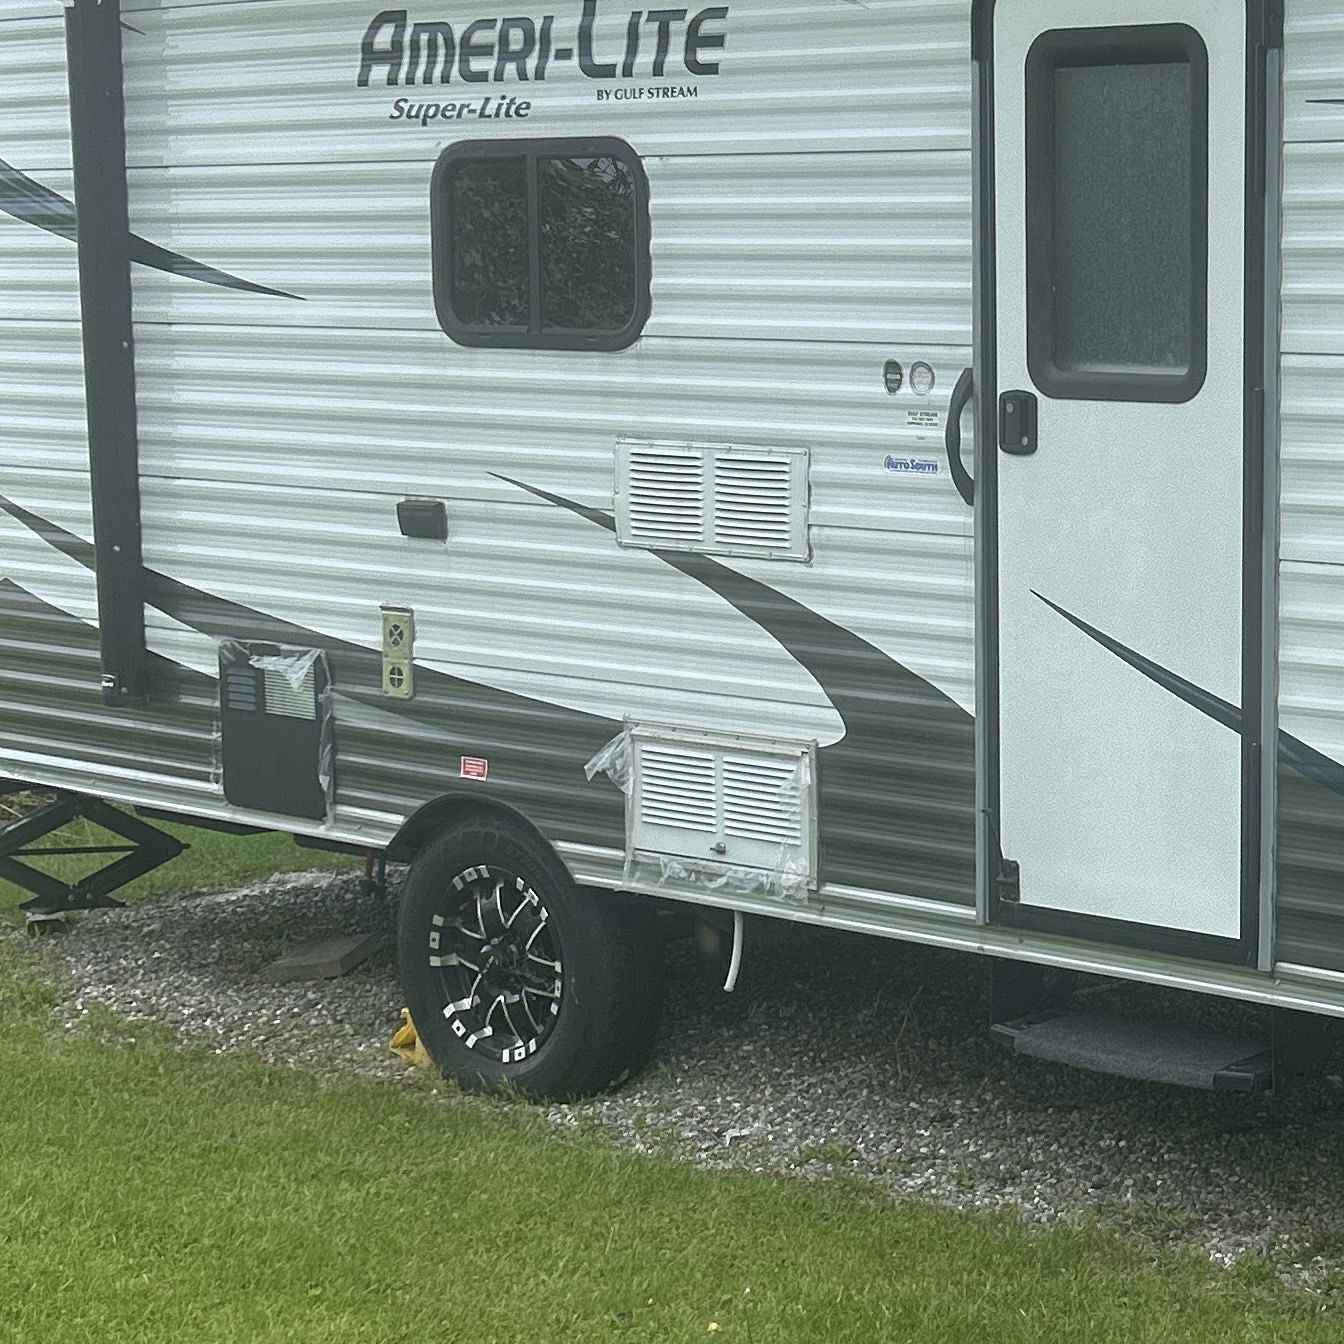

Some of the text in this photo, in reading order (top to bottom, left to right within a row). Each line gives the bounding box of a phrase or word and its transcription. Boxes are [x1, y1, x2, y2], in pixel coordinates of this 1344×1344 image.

[596, 85, 698, 101] BY GULF STREAM
[388, 94, 532, 127] Super-Lite
